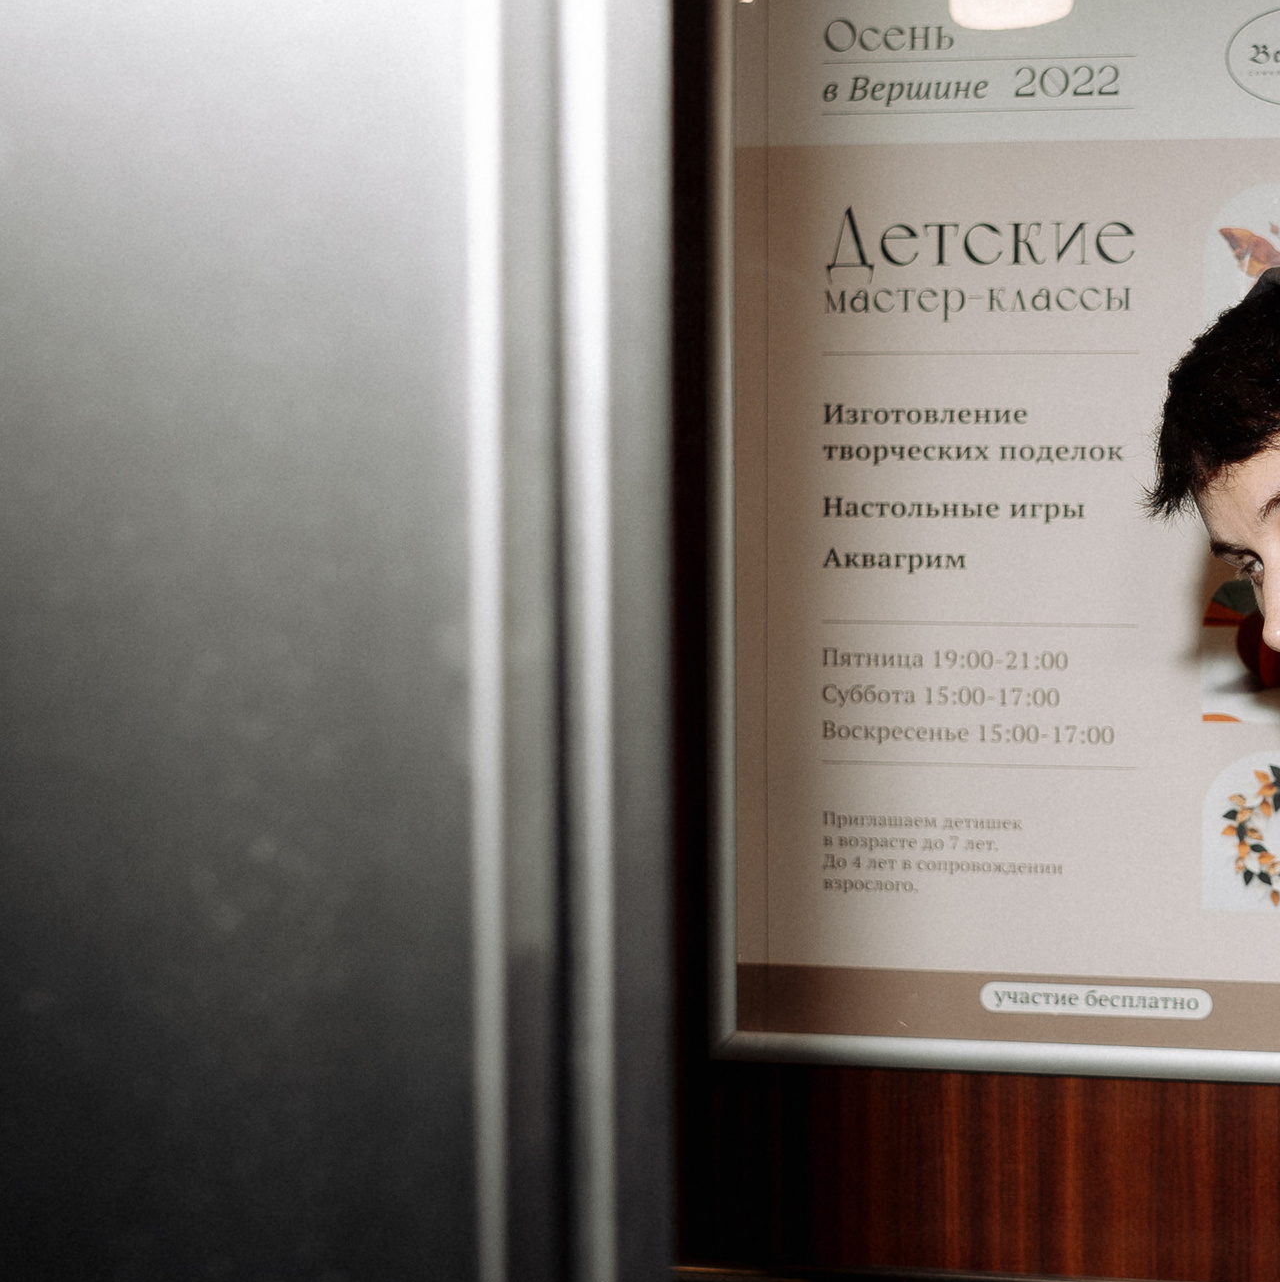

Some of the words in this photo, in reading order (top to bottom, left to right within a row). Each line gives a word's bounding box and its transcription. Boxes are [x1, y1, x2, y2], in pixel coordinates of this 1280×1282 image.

[825, 19, 954, 52] Осень
[823, 82, 839, 103] в
[848, 75, 989, 107] Вершине
[1015, 65, 1120, 98] 2022
[825, 205, 1135, 284] Детские
[824, 286, 1132, 323] мастер-классы
[823, 403, 1028, 425] Изготовление
[823, 444, 989, 466] творческих
[999, 444, 1124, 464] поделок
[823, 496, 1000, 518] Настольные
[1010, 502, 1085, 524] игры
[823, 547, 967, 574] Аквагрим
[822, 647, 924, 671] Пятница
[933, 650, 1069, 671] 19:00-21:00
[822, 684, 916, 708] Суббота
[924, 687, 1061, 708] 15:00-17:00
[822, 720, 970, 745] Воскресенье
[978, 724, 1115, 746] 15:00-17:00
[822, 810, 937, 829] Приглашаем
[942, 818, 1022, 831] детишек
[823, 835, 833, 847] в
[838, 835, 918, 851] возрасте
[922, 838, 945, 851] до
[949, 836, 960, 850] 7
[822, 853, 848, 871] До
[852, 855, 862, 868] 4
[866, 858, 898, 870] лет
[902, 859, 912, 870] в
[917, 859, 1063, 875] сопровождении
[994, 989, 1079, 1007] участие
[1085, 989, 1199, 1010] бесплатно
